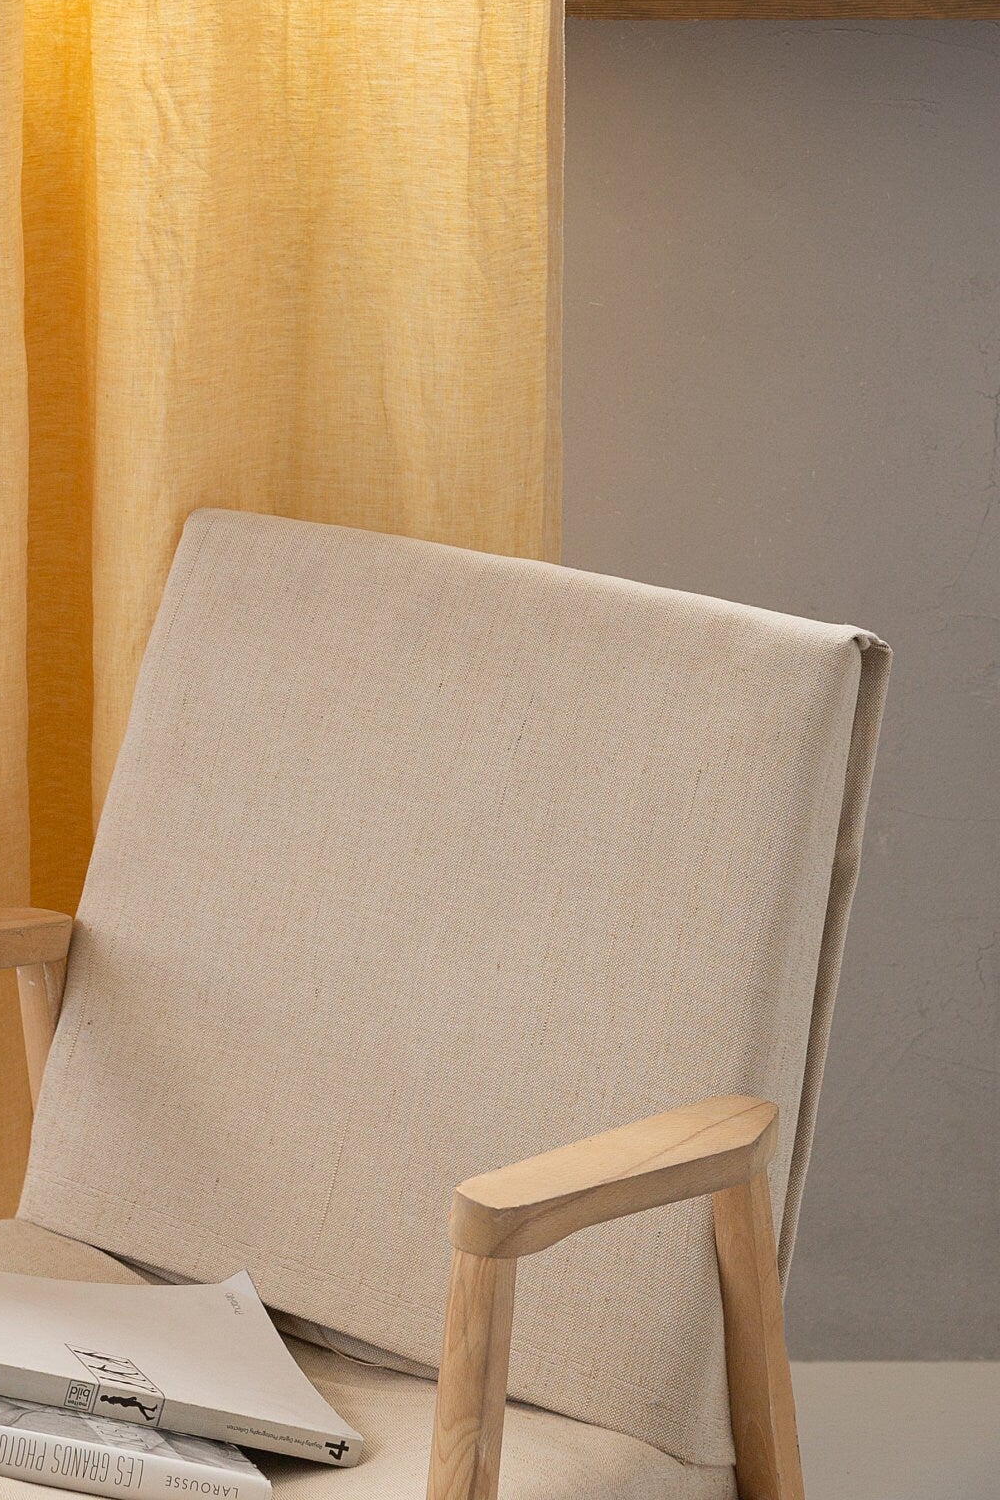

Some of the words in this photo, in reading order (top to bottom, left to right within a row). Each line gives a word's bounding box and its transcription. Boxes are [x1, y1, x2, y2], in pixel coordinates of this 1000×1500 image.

[69, 1386, 91, 1403] bild
[226, 1425, 249, 1435] Collection
[249, 1428, 279, 1441] Photography
[50, 1443, 110, 1483] GRANDS
[114, 1455, 144, 1489] LES
[165, 1475, 240, 1499] LAROUSSE
